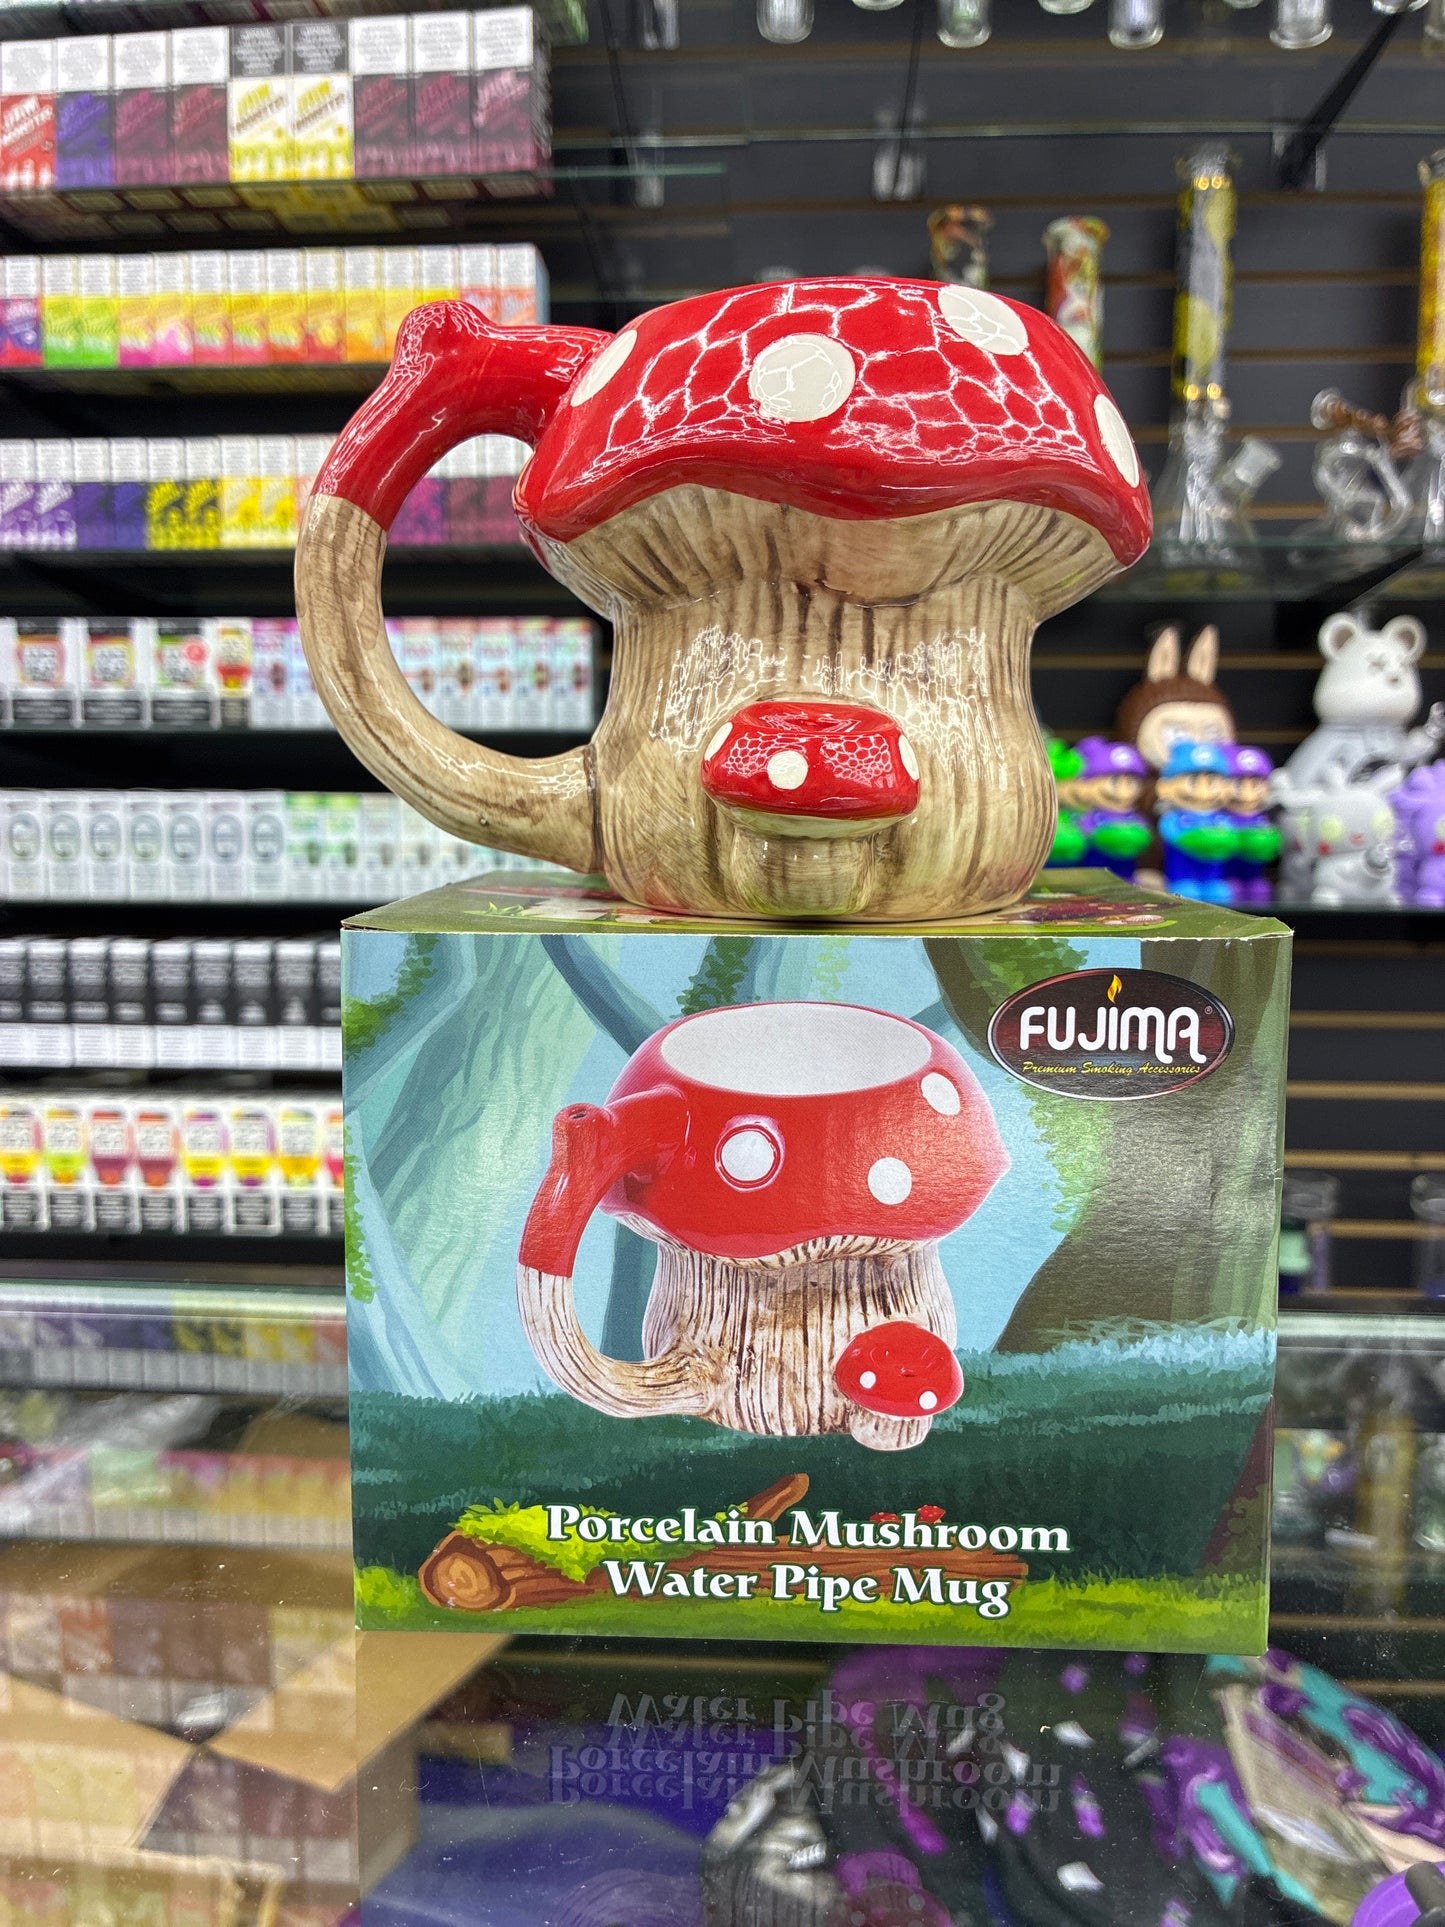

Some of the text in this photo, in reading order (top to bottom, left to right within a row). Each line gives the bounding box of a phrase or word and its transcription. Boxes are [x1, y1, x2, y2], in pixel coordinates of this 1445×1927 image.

[1019, 1006, 1207, 1064] FUJIMA
[1022, 1060, 1201, 1076] Premium Smoking Accessories
[546, 1504, 1071, 1551] Porcelain Mushroom
[602, 1559, 1010, 1618] Water Pipe Mug
